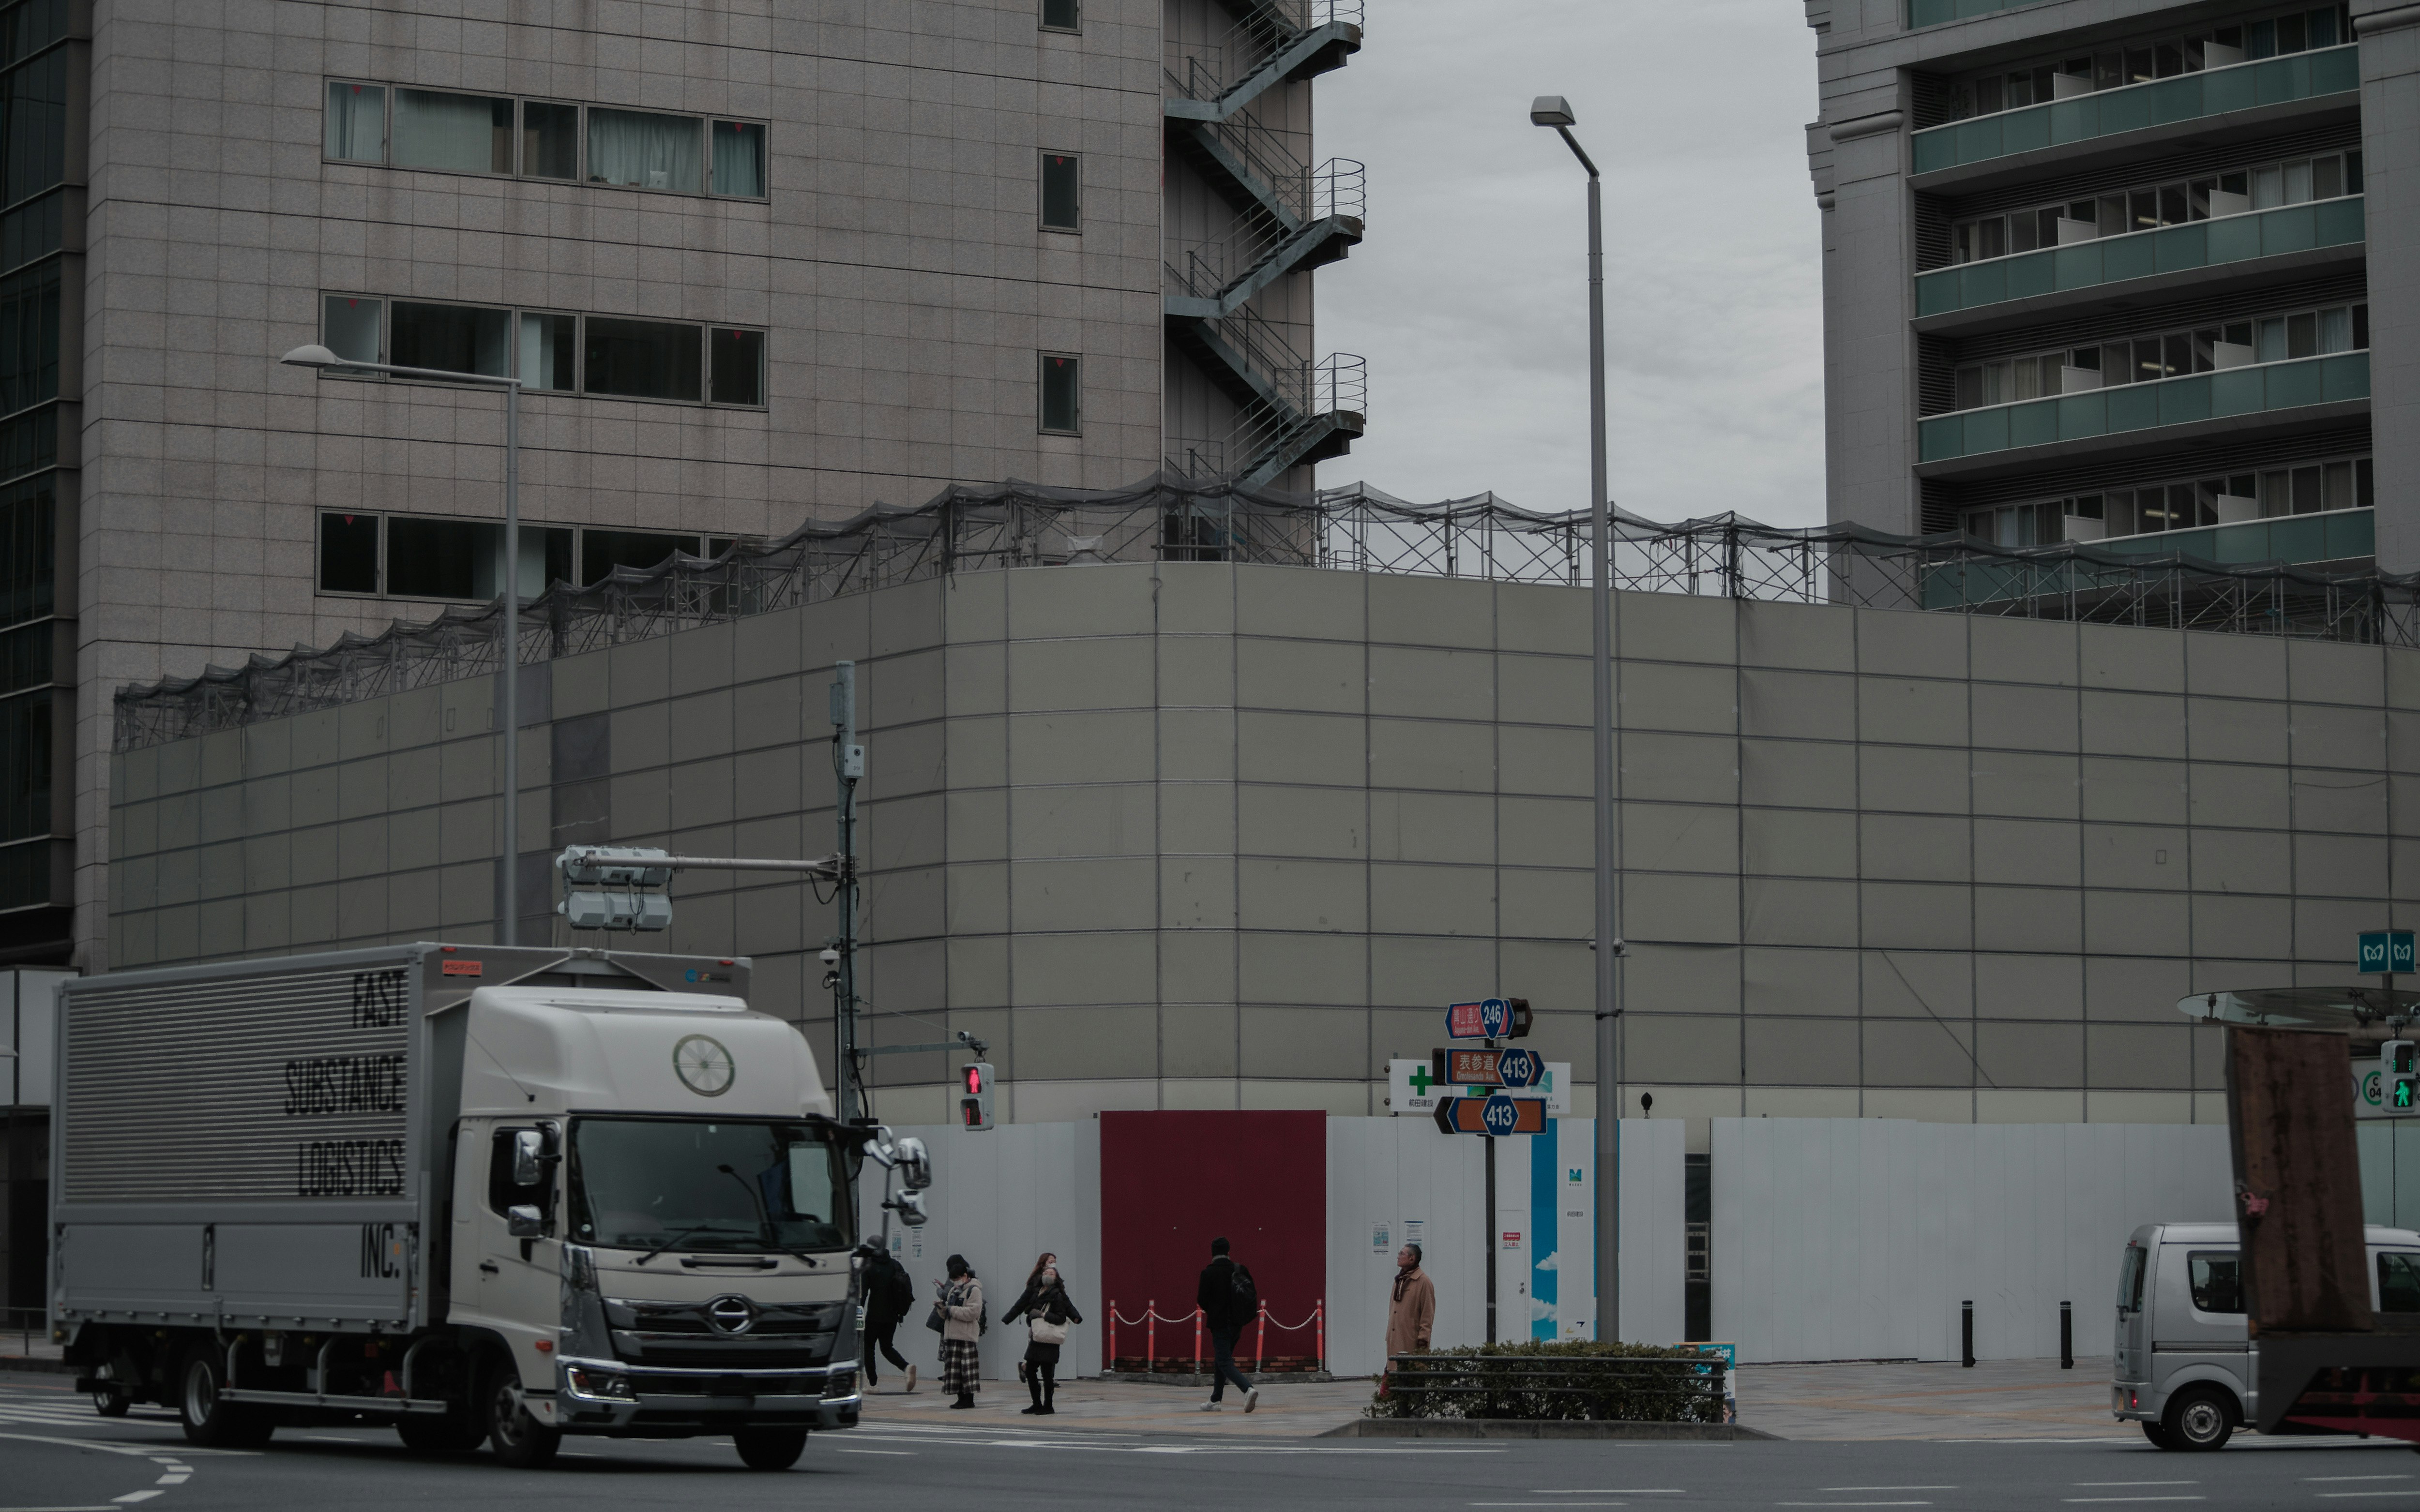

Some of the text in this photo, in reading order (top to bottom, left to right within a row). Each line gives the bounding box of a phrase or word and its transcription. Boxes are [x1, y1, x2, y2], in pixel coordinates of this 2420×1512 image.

[352, 969, 404, 1029] FAST
[1453, 1007, 1479, 1024] 青山通り
[1483, 1004, 1501, 1024] 246
[1459, 1053, 1494, 1071] 表参道
[1502, 1057, 1528, 1079] 413
[285, 1056, 404, 1114] SUBSTANCE
[1457, 1071, 1495, 1081] Omotesando Ave.
[2373, 1076, 2378, 1087] C
[2369, 1087, 2381, 1098] 04
[1408, 1099, 1433, 1108] 前田建設
[1486, 1104, 1512, 1126] 413
[298, 1140, 402, 1197] LOGISTICS
[361, 1224, 400, 1279] INC.
